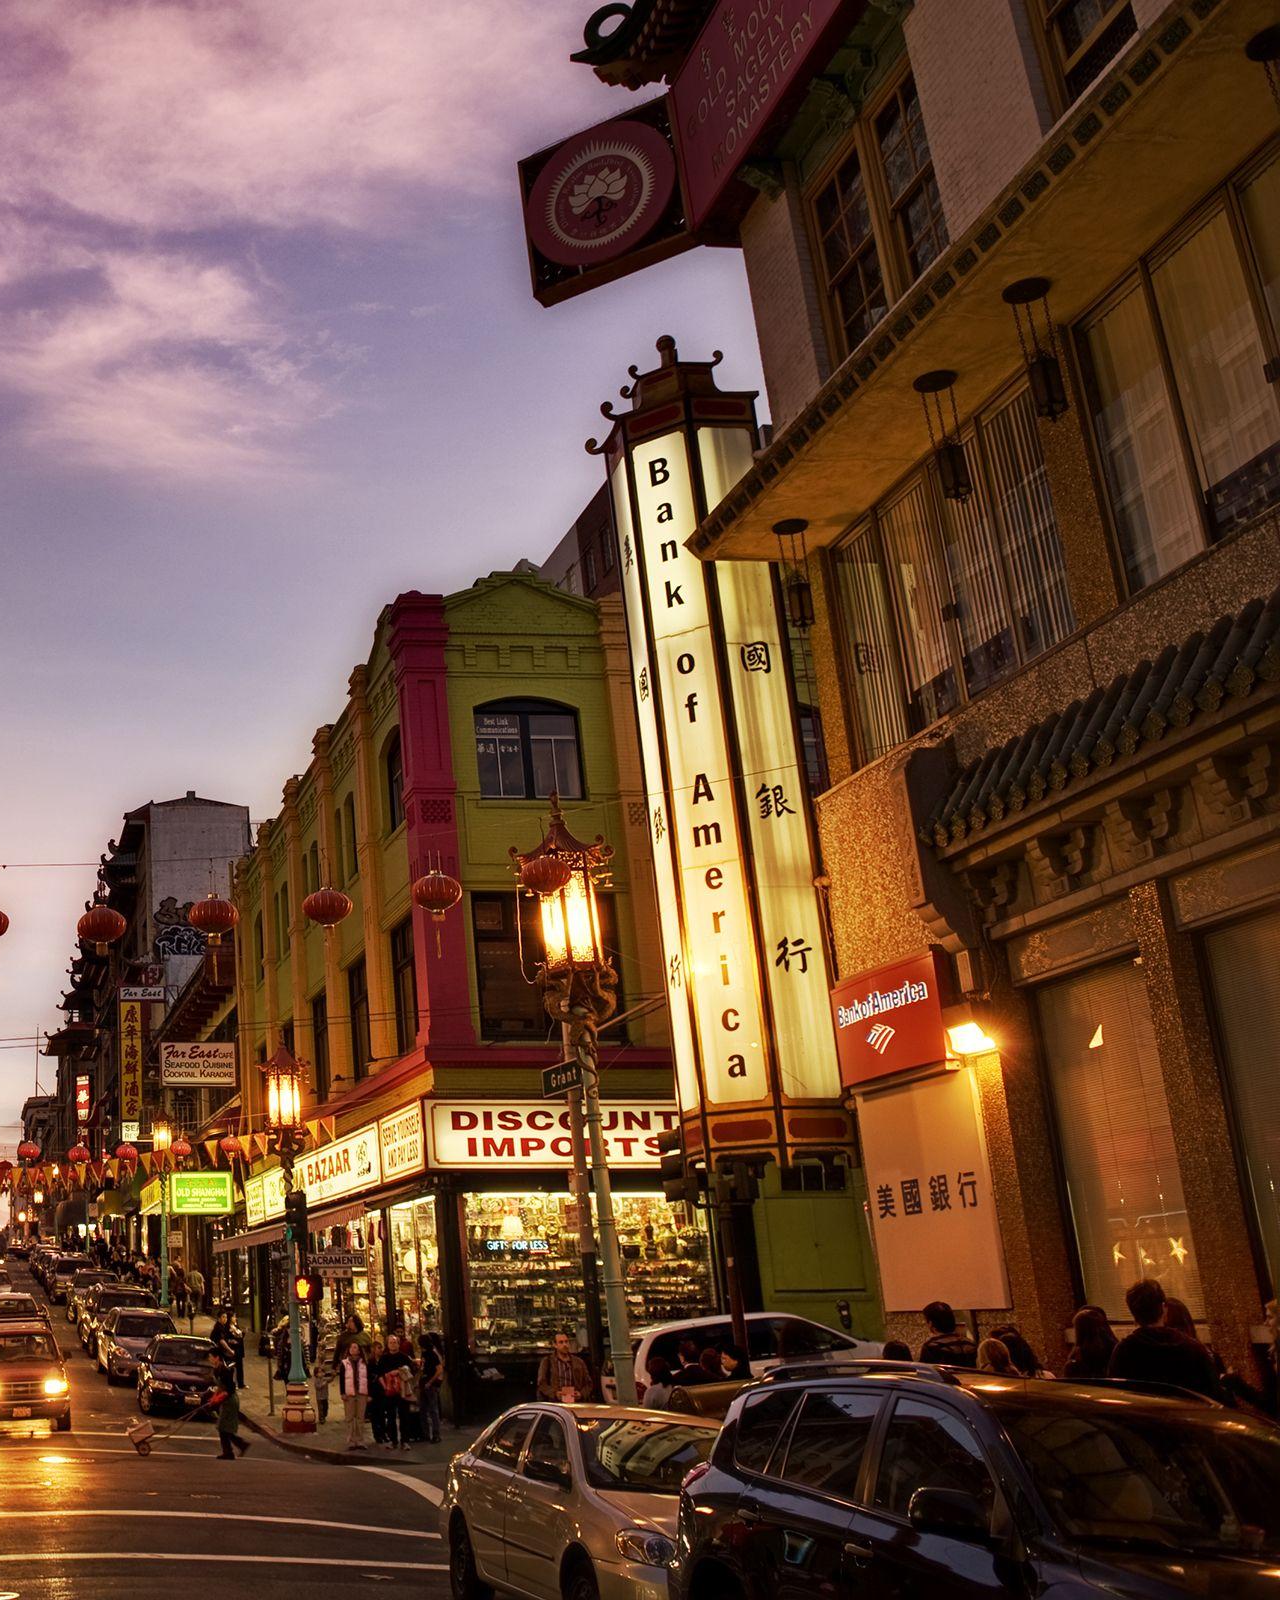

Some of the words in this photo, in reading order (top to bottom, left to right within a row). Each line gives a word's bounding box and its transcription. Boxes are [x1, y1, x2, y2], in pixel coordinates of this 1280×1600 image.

[733, 0, 771, 64] MOU
[725, 4, 785, 117] SAGELY
[711, 0, 814, 177] MONASTERY
[647, 456, 685, 609] Bank
[676, 652, 699, 724] of
[691, 773, 748, 1079] America
[740, 640, 814, 974] 國銀行
[122, 988, 138, 998] Far
[141, 989, 162, 997] East
[163, 1044, 187, 1060] Far
[188, 1045, 219, 1059] East
[163, 1069, 198, 1078] COCKTAIL
[199, 1069, 234, 1078] KARAOKE
[164, 1060, 200, 1069] SEAFOOD
[202, 1060, 234, 1069] CUISINE
[550, 1067, 577, 1087] Grant
[382, 1124, 397, 1147] SERVE
[407, 1139, 418, 1162] LESS
[307, 1148, 352, 1186] BAZAAR
[176, 1188, 190, 1197] OLD
[876, 1170, 979, 1220] 美國銀行
[486, 1240, 510, 1250] GIFTS
[511, 1240, 529, 1250] FOR
[529, 1240, 549, 1250] LESS
[306, 1256, 363, 1265] SACRAMENTO
